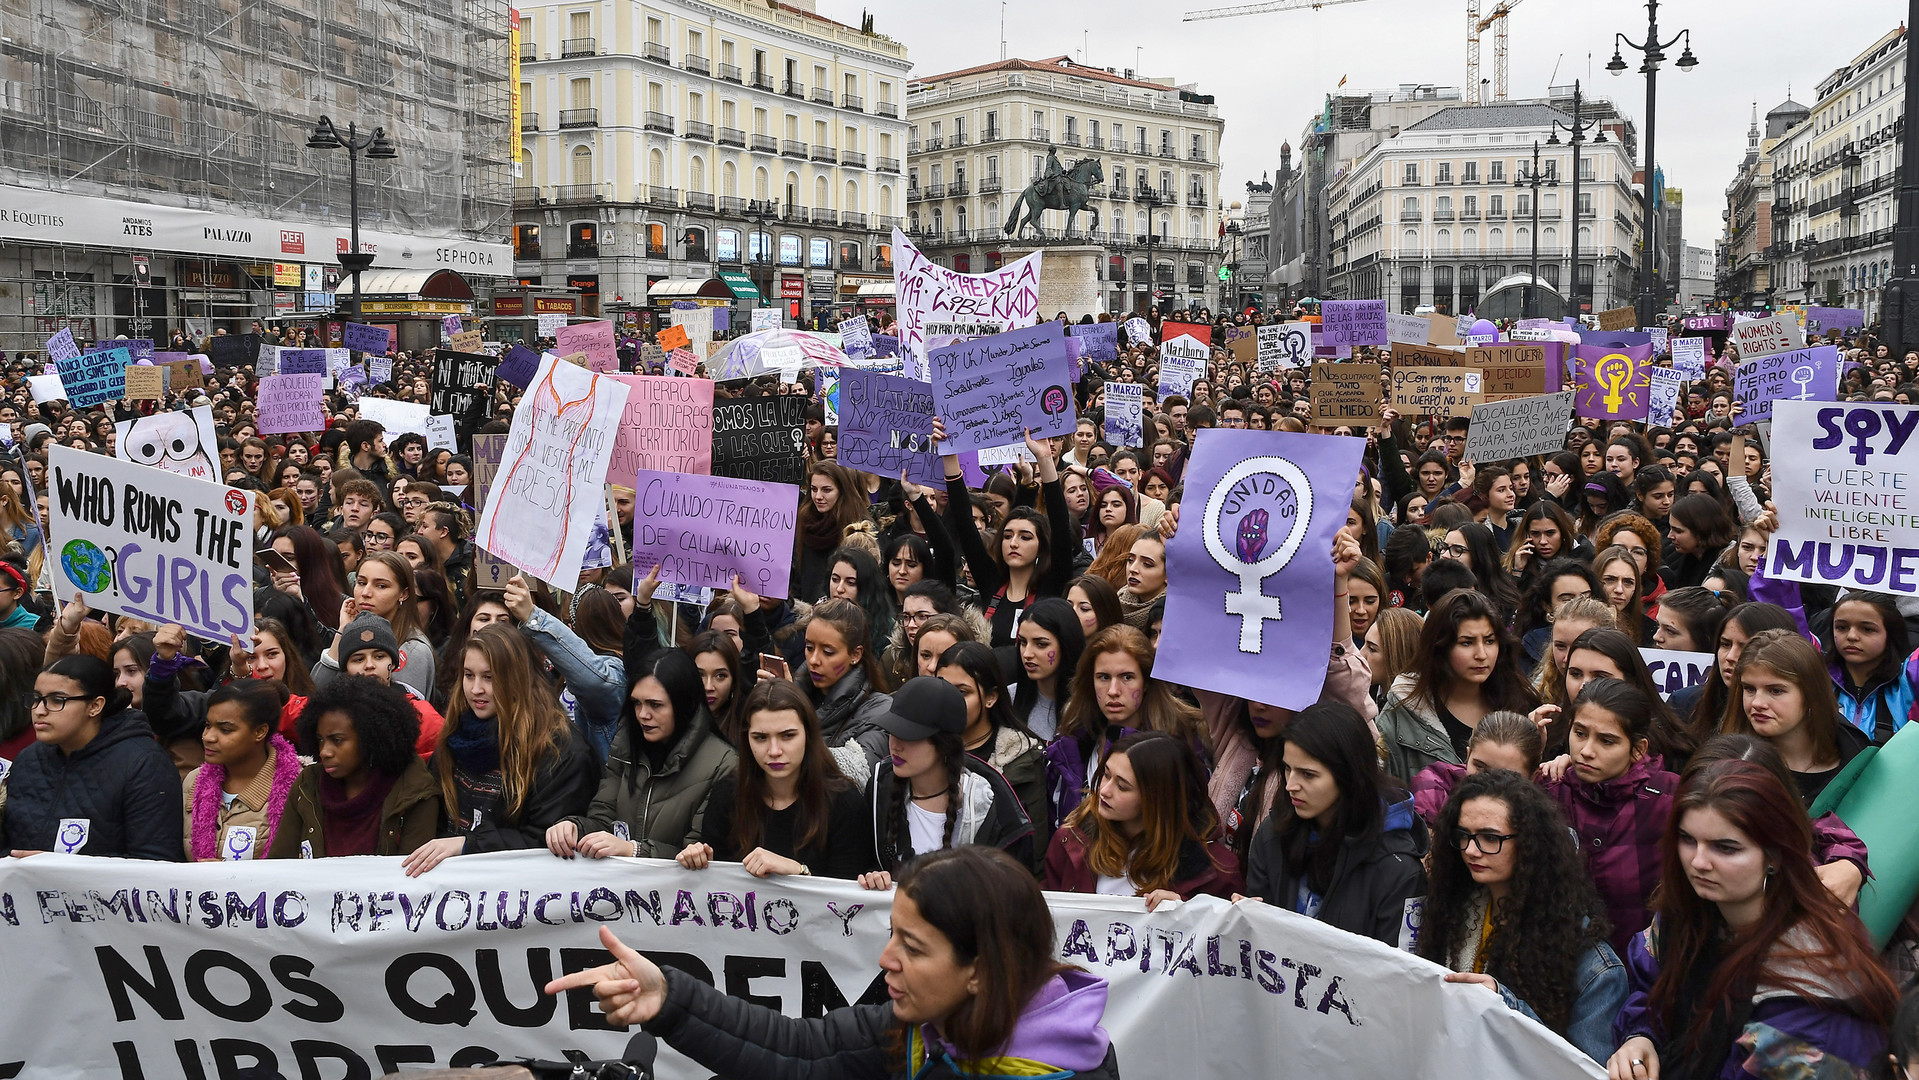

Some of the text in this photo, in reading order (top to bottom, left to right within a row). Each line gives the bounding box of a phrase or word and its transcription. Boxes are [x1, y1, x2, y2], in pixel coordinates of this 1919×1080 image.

[122, 217, 152, 226] ANDAMIOS
[123, 224, 153, 237] ATES
[203, 227, 252, 243] PALAZZO
[281, 231, 303, 243] DEFI
[717, 236, 734, 246] Fibra
[782, 242, 796, 250] Fibra
[436, 248, 494, 266] SEPHORA
[570, 280, 595, 288] Orange
[546, 302, 573, 311] TABACOS
[1327, 302, 1384, 313] SOMOS LAS HIJAS
[845, 316, 866, 328] MARZO
[1325, 312, 1383, 323] DE LAS BRUJAS
[1688, 318, 1717, 329] GIRL
[926, 324, 966, 335] HOY PARO POR
[1325, 323, 1352, 332] QUE NO
[1737, 322, 1783, 340] WOMEN'S
[597, 331, 607, 339] EL
[1258, 333, 1278, 342] MUJER
[1334, 330, 1379, 343] QUEMAR
[1259, 341, 1277, 350] LIBRE
[1679, 338, 1703, 346] MARZO
[1743, 338, 1776, 354] RIGHTS
[1164, 339, 1206, 362] Marlboro
[1474, 348, 1543, 363] EN MI CUERPO
[591, 359, 607, 367] VOZ
[1170, 357, 1195, 368] MARZO
[1396, 352, 1442, 367] HERMANA
[1738, 351, 1811, 379] NO SOY UN
[437, 358, 453, 387] NI
[1496, 368, 1531, 380] DECIDO
[1652, 367, 1682, 381] MARZO
[99, 380, 106, 390] LA
[264, 376, 318, 390] POR AQUELLAS
[1333, 381, 1360, 389] TANTO
[1405, 372, 1427, 383] Con
[1430, 375, 1451, 389] ropa
[1503, 382, 1514, 390] TÚ
[1740, 371, 1787, 390] PERRO
[1106, 384, 1142, 396] 8 MARZO
[1416, 385, 1427, 394] sin
[1737, 384, 1783, 404] NO ME
[274, 392, 284, 402] NO
[432, 390, 446, 412] NI
[1396, 395, 1406, 405] MI
[1408, 395, 1440, 406] CUERPO
[1443, 395, 1455, 406] NO
[1458, 395, 1470, 406] SE
[273, 401, 310, 414] ESTO PORQUE
[758, 396, 807, 427] LA VOZ
[1319, 405, 1373, 417] EL MIEDO
[1420, 406, 1450, 416] TOCA
[276, 413, 323, 427] ASESINADAS
[547, 413, 561, 437] ME
[1482, 407, 1568, 434] NO MÁS
[974, 430, 981, 443] 8
[1468, 433, 1508, 449] GUAPA,
[1540, 423, 1565, 436] QUE
[1812, 408, 1919, 466] SOY
[730, 430, 788, 460] LAS QUE
[1482, 447, 1508, 461] POCO
[1509, 443, 1530, 456] MÁS
[1531, 439, 1564, 454] MUERTA
[159, 461, 169, 469] EL
[187, 466, 206, 477] UNA
[578, 460, 594, 483] MI
[1814, 469, 1908, 490] FUERTE
[507, 461, 577, 523] AGRESOR
[642, 478, 793, 531] CUANDO TRATARON
[1225, 478, 1296, 520] UNIDAS
[55, 465, 244, 569] WHO RUNS THE
[642, 525, 775, 563] DE CALLARNOS,
[117, 542, 249, 636] GIRLS
[36, 888, 310, 929] FEMINISMO
[331, 886, 800, 936] REVOLUCIONARIO
[826, 901, 864, 937] Y
[95, 944, 344, 1023] NOS
